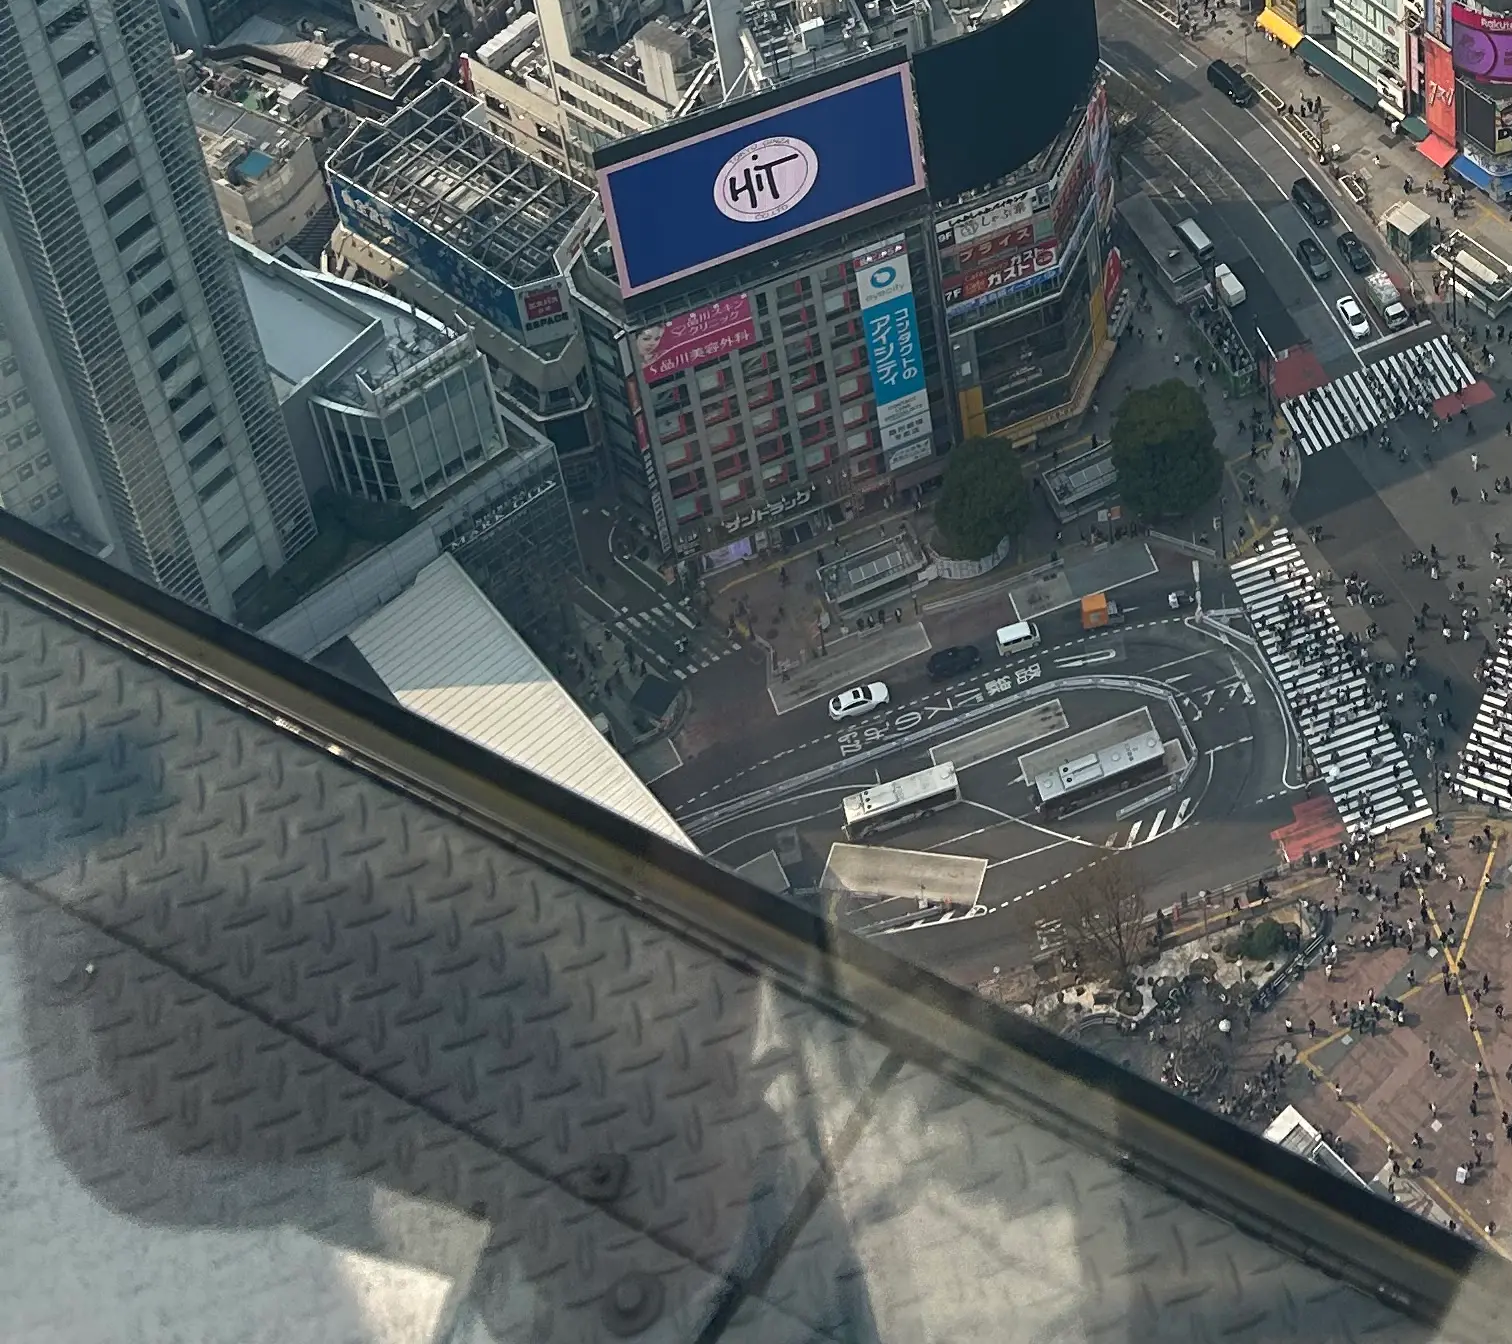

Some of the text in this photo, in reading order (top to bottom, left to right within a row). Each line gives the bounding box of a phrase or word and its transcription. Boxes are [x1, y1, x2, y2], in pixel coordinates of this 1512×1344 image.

[944, 287, 962, 302] 7F
[987, 263, 1031, 289] ガスト
[659, 328, 753, 374] 品川美容外科
[868, 313, 899, 387] アイシティ
[893, 306, 919, 382] コンタクトの
